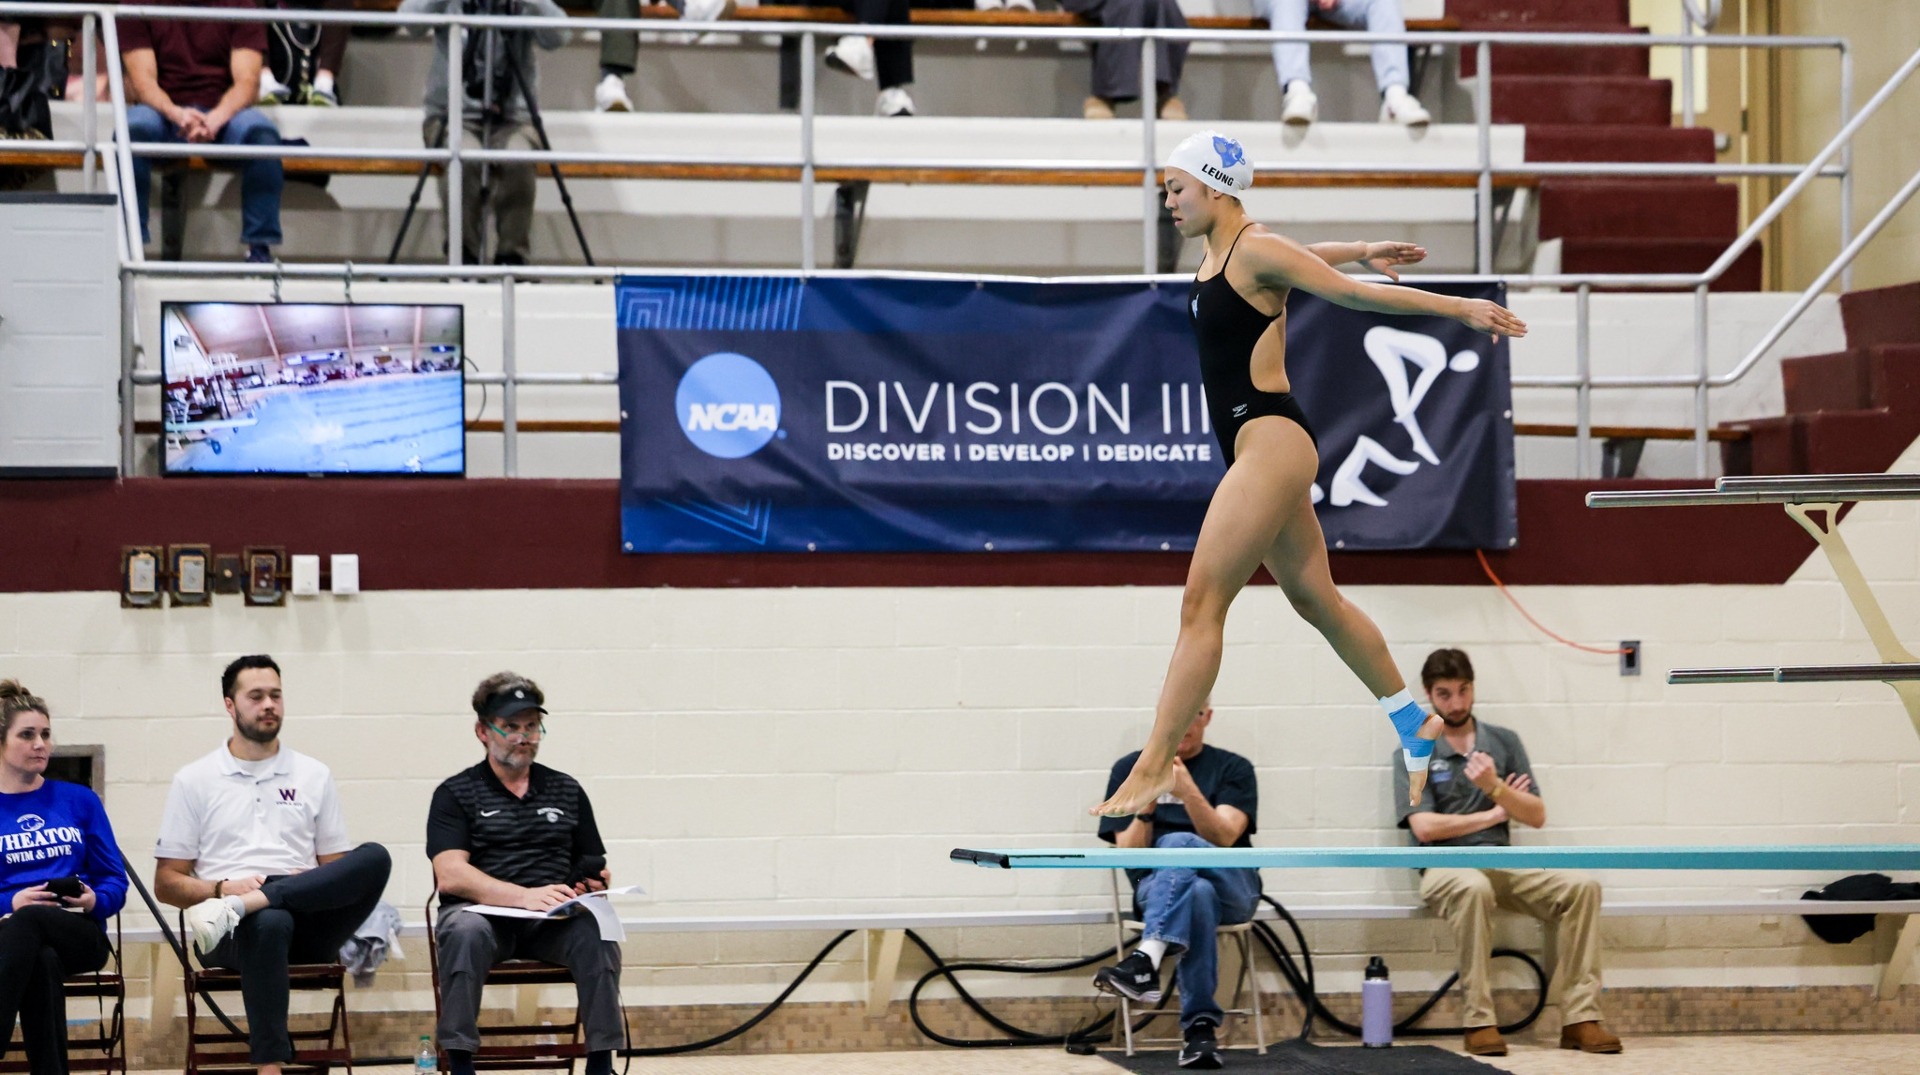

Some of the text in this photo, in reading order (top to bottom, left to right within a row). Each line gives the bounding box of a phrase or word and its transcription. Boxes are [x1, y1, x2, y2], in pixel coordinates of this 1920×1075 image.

[1201, 163, 1234, 187] LEUNG
[687, 403, 779, 431] NCAA
[825, 380, 1130, 435] DIVISION
[827, 443, 945, 461] DISCOVER
[968, 443, 1075, 462] DEVELOP
[1097, 443, 1212, 462] DEDICATE
[278, 788, 296, 801] W
[0, 826, 82, 852] HEATON
[5, 844, 72, 864] SWIM & DIVE
